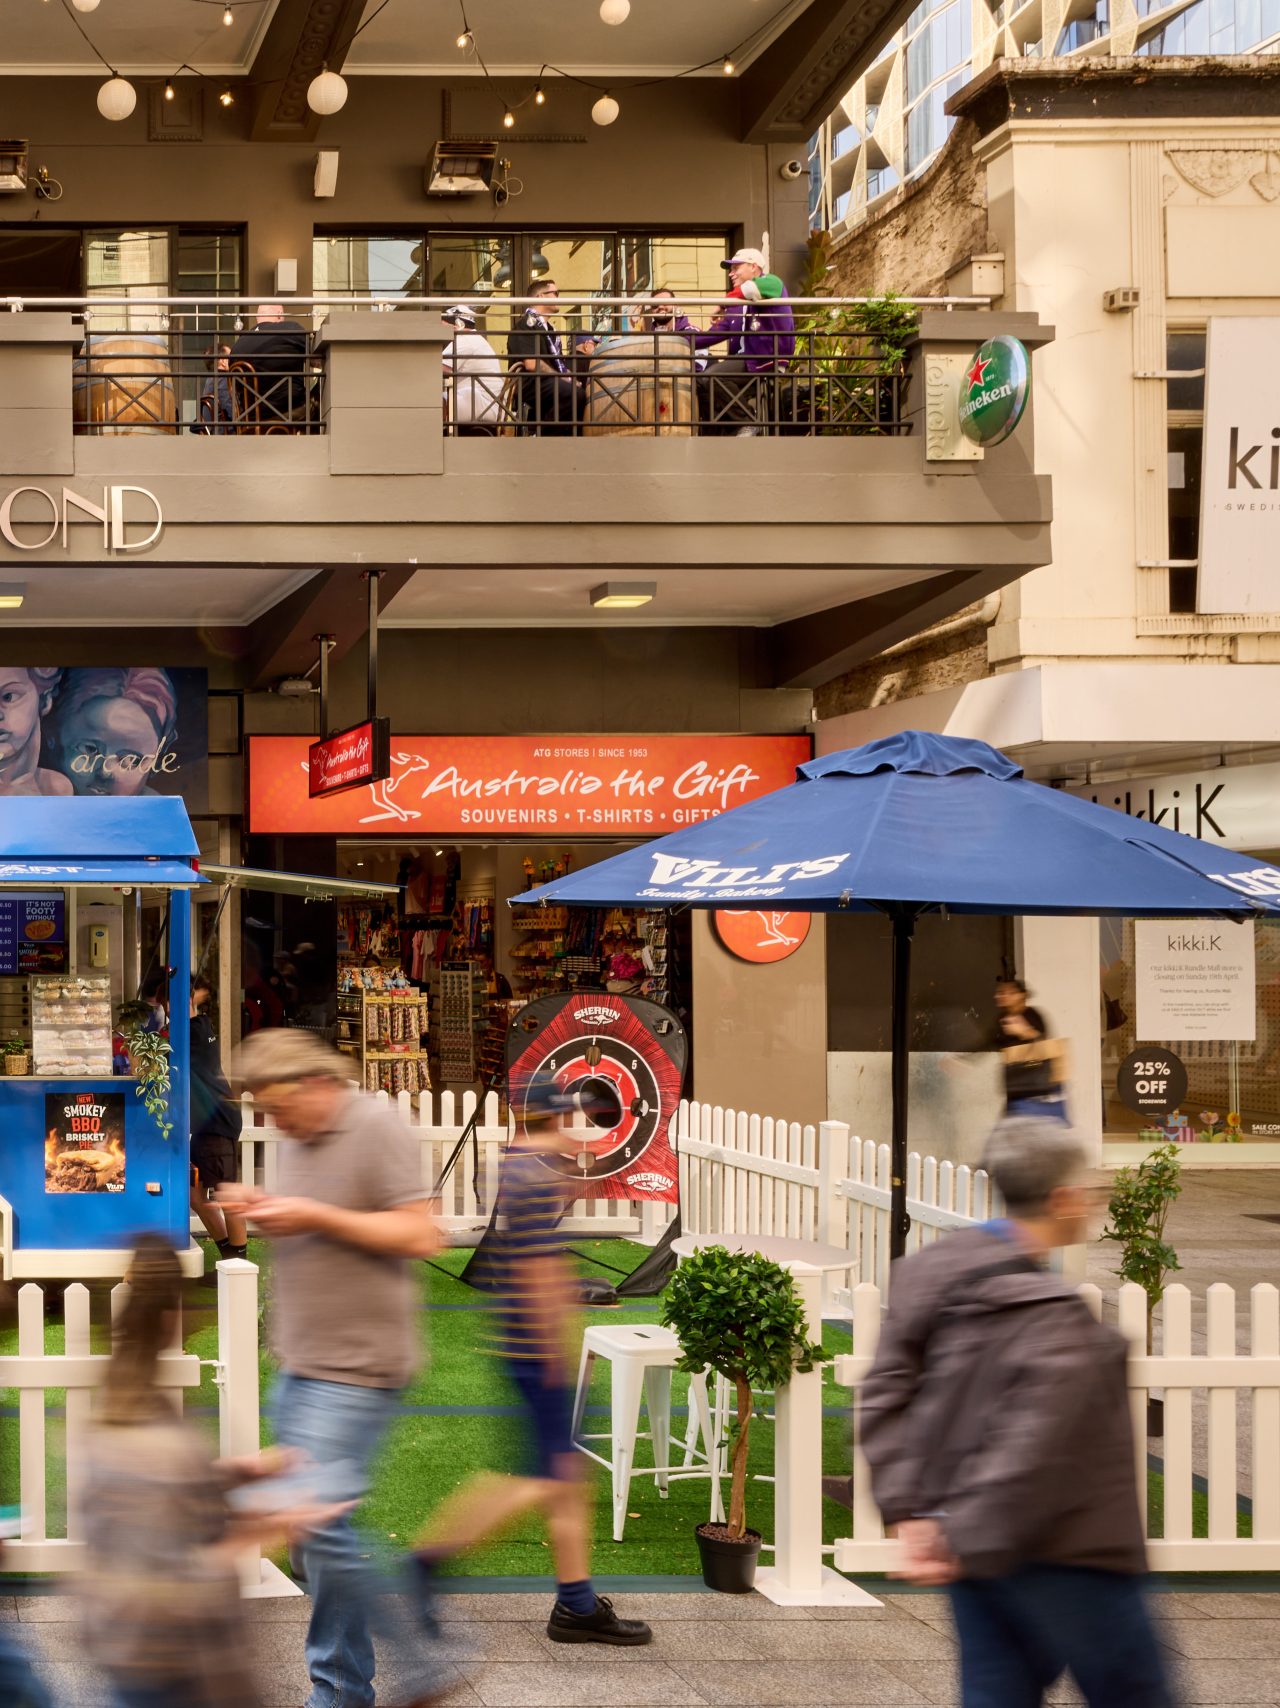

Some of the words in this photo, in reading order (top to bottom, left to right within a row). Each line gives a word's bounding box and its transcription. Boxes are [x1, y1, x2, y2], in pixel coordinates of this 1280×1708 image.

[1226, 503, 1280, 511] SWEDI
[70, 735, 181, 775] arcade
[533, 749, 551, 758] ATG
[554, 749, 590, 758] STORES
[598, 749, 625, 758] SINCE
[628, 749, 648, 758] 1953
[421, 766, 602, 800] Australia
[610, 769, 665, 797] the
[673, 761, 760, 809] Gift
[460, 809, 558, 824] SOUVENIRS
[577, 809, 653, 823] T-SHIRTS
[649, 852, 851, 887] VILI'S
[1168, 935, 1222, 951] kikki.K
[574, 1006, 620, 1020] SHERRIN
[550, 1060, 556, 1069] 5
[631, 1060, 637, 1069] 5
[1134, 1062, 1170, 1075] 25%
[617, 1073, 622, 1083] 7
[1135, 1081, 1167, 1094] OFF
[64, 1104, 107, 1117] SMOKEY
[71, 1117, 101, 1132] BBQ
[66, 1133, 105, 1141] BRISKET
[612, 1133, 617, 1142] 7
[80, 1141, 92, 1149] PIE
[625, 1148, 630, 1157] 5
[627, 1172, 673, 1188] SHERRIN
